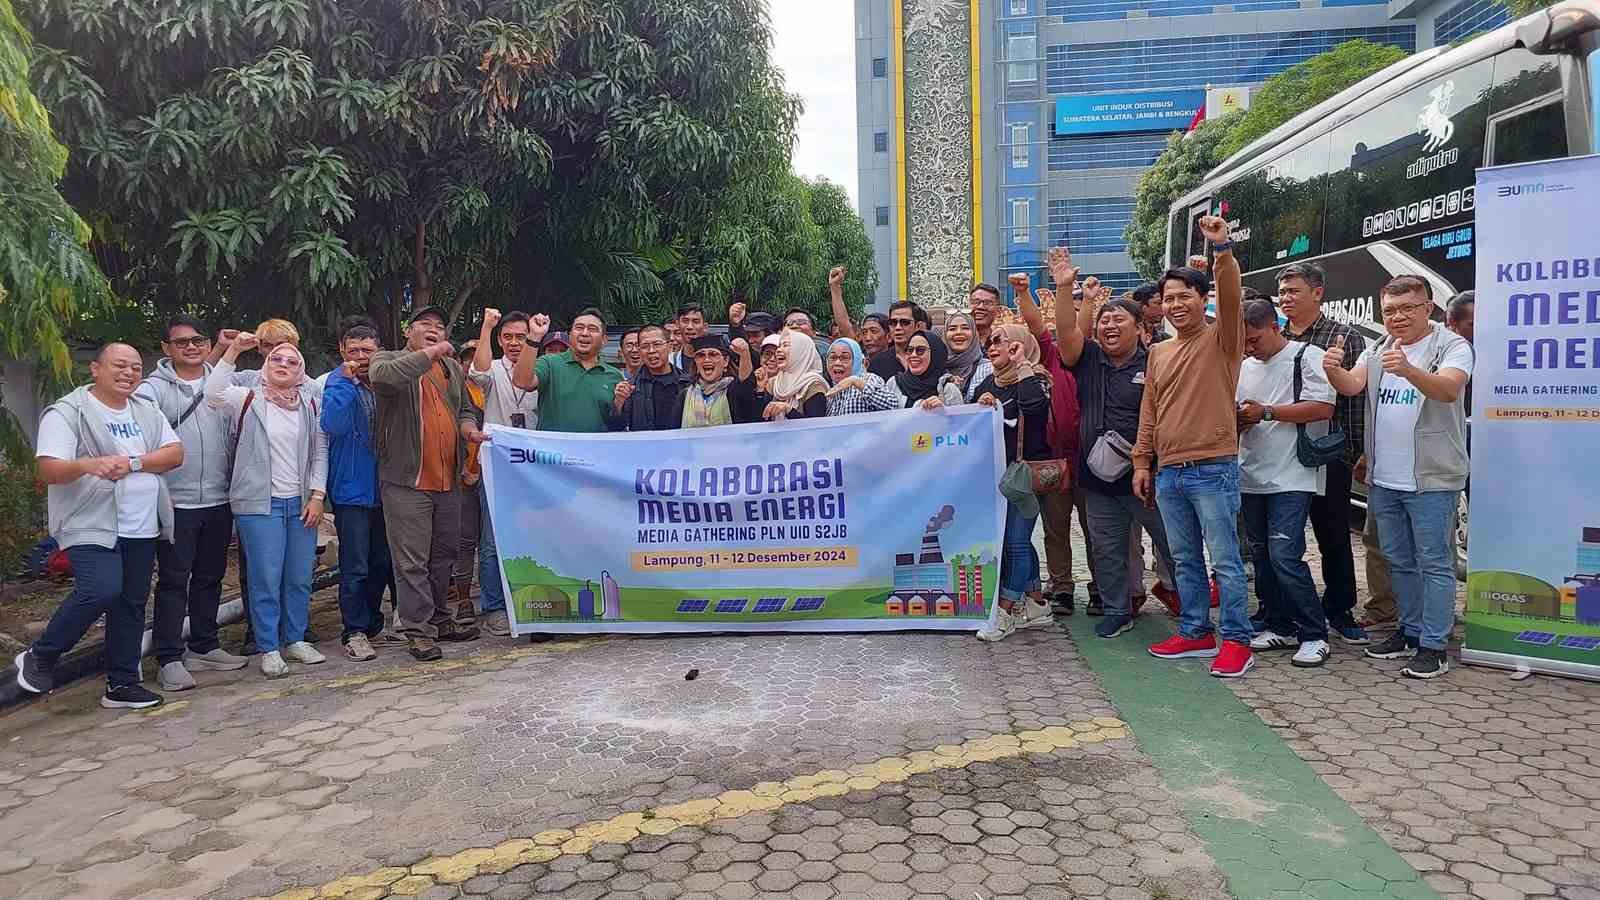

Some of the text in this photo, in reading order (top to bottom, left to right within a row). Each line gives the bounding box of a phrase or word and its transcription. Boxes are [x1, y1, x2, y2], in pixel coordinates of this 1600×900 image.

[1135, 101, 1174, 109] DISTRIBUSI
[1136, 111, 1157, 119] JAMBI
[1406, 147, 1458, 179] adiputro
[1322, 296, 1374, 325] PERSADA
[1494, 385, 1598, 395] MEDIA GATHERING
[1556, 409, 1565, 417] 11
[1577, 409, 1589, 418] 12
[935, 433, 969, 448] PLN
[635, 458, 843, 496] KOLABORASI
[638, 492, 845, 524] MEDIA ENERGI
[638, 524, 848, 544] MEDIA GATHERING PLN UID S2JB
[644, 554, 706, 568] Lampung,
[710, 553, 720, 564] 11
[731, 553, 744, 564] 12
[747, 551, 811, 563] Desember
[814, 550, 847, 561] 2024
[1480, 591, 1527, 604] BIOGAS
